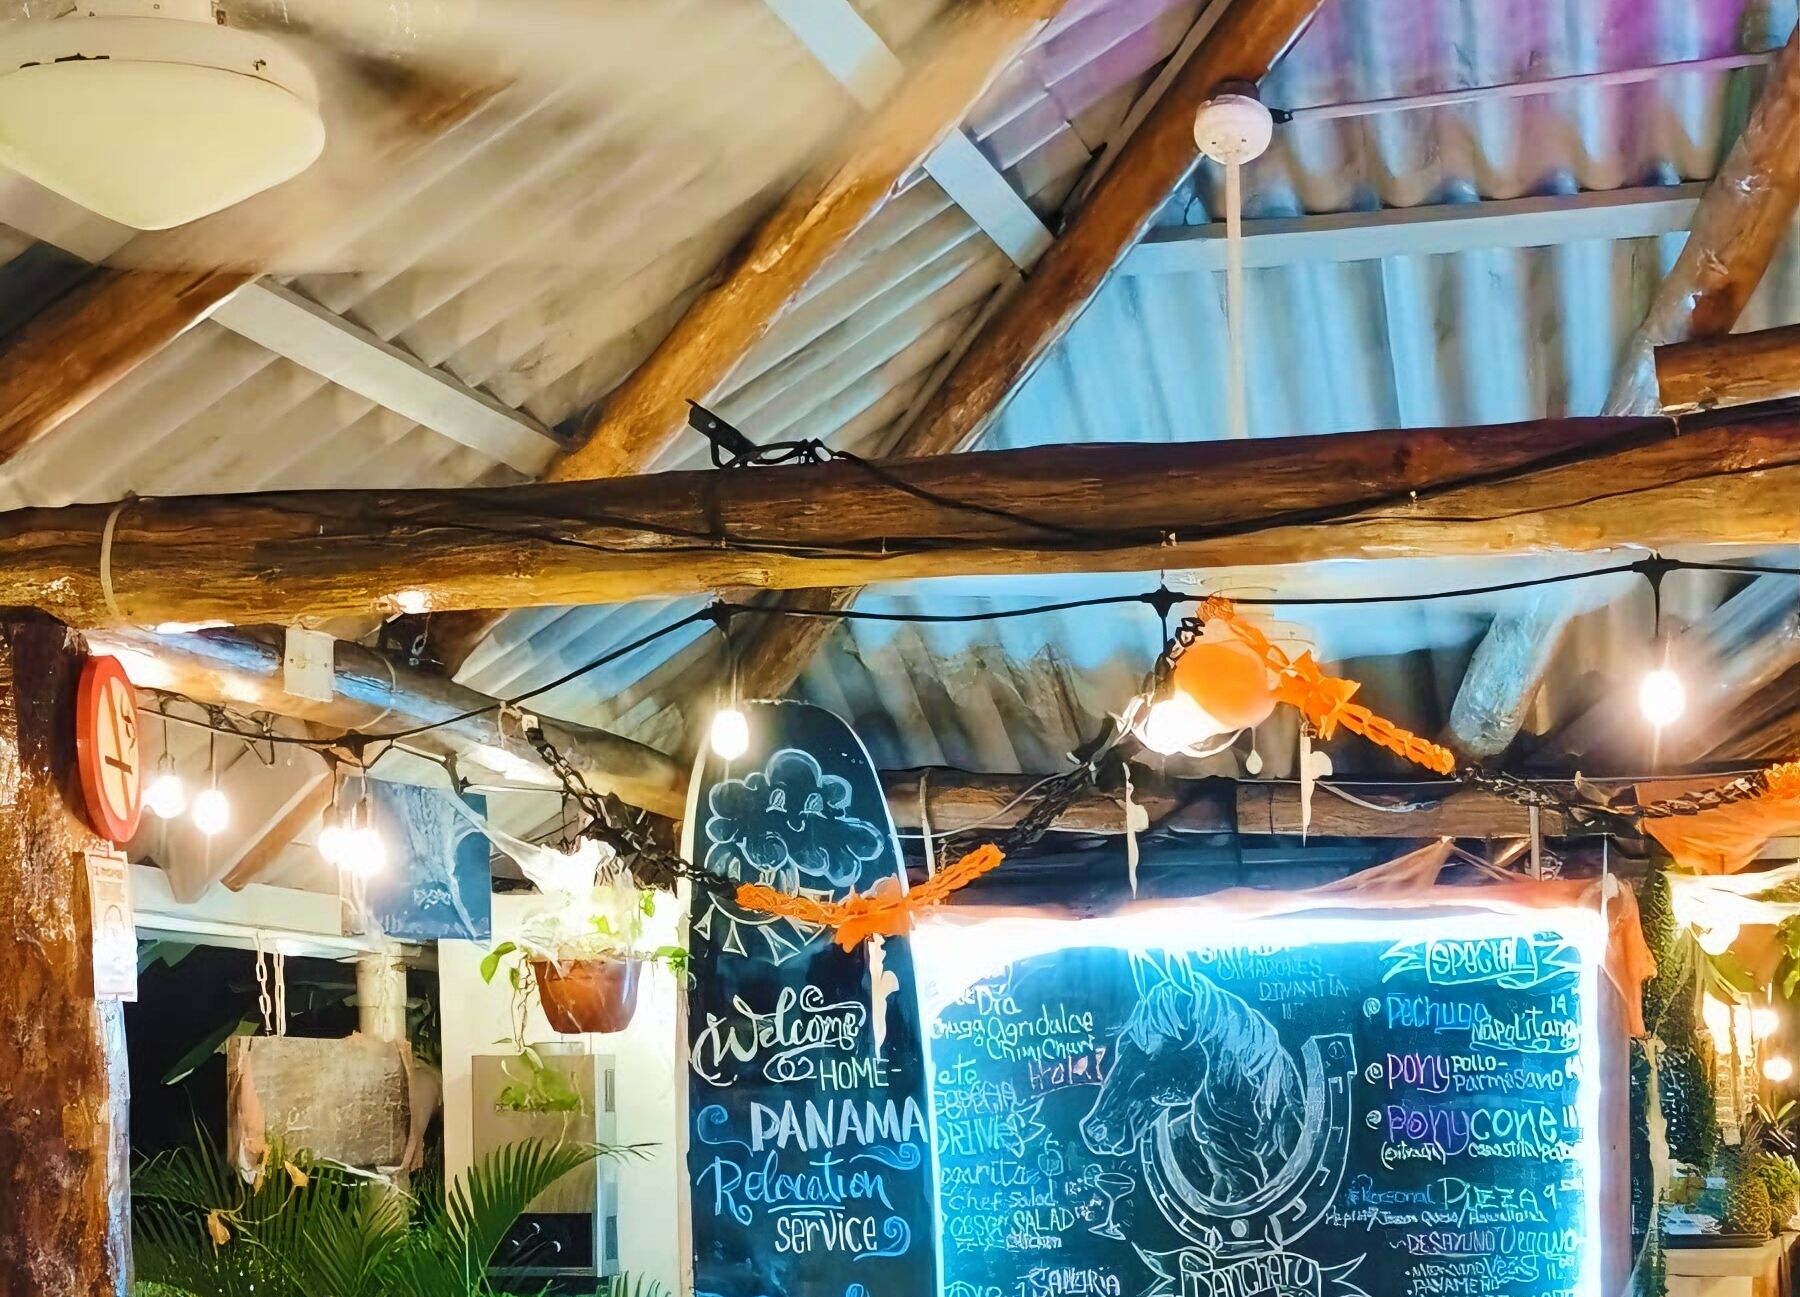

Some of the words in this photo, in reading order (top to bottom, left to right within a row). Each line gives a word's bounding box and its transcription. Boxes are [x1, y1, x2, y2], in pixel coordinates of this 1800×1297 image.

[690, 985, 867, 1086] Welcome
[750, 1096, 928, 1152] PANAMA
[697, 1150, 894, 1226] Relocation
